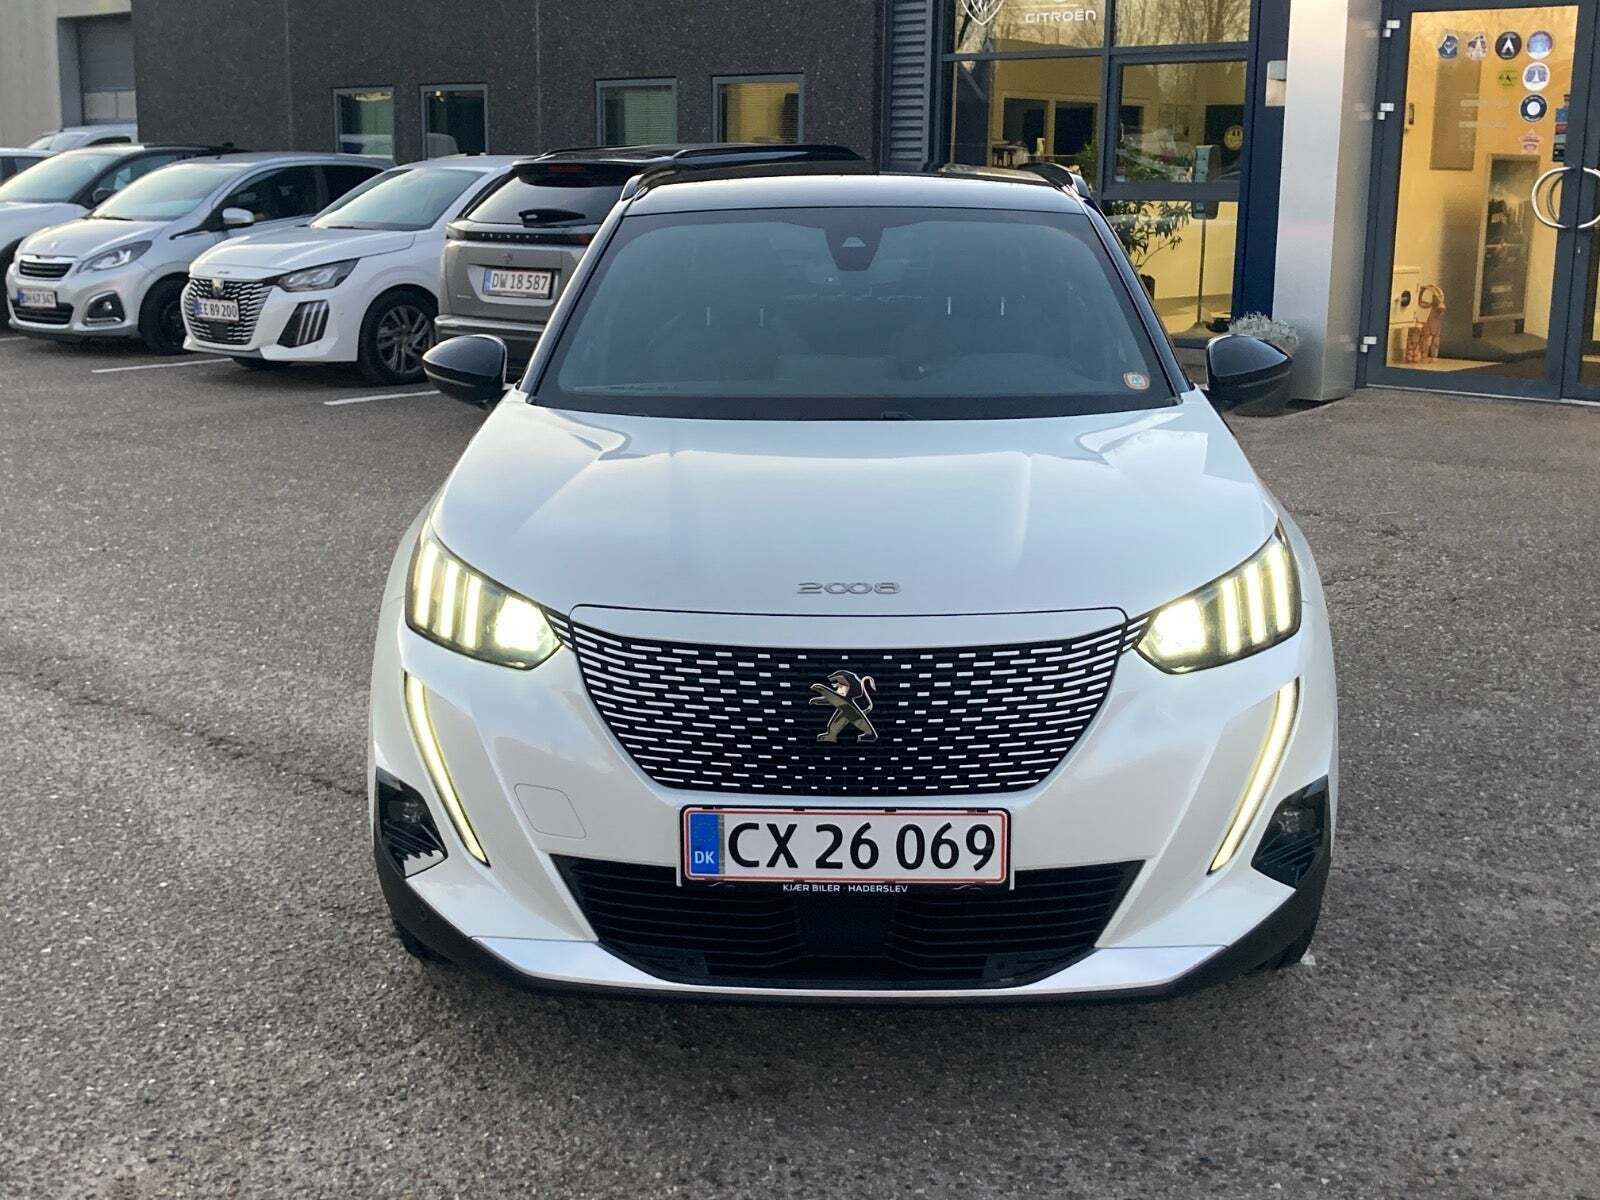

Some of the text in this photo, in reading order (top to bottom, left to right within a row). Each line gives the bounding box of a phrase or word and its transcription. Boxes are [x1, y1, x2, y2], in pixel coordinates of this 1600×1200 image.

[491, 273, 549, 291] DW 18 587
[210, 303, 220, 317] 89
[221, 304, 238, 318] 200
[797, 582, 901, 594] 2008
[728, 822, 996, 871] CX 26 069
[694, 850, 715, 864] DK
[783, 884, 908, 893] KJÆR BILER HADERSLEV
